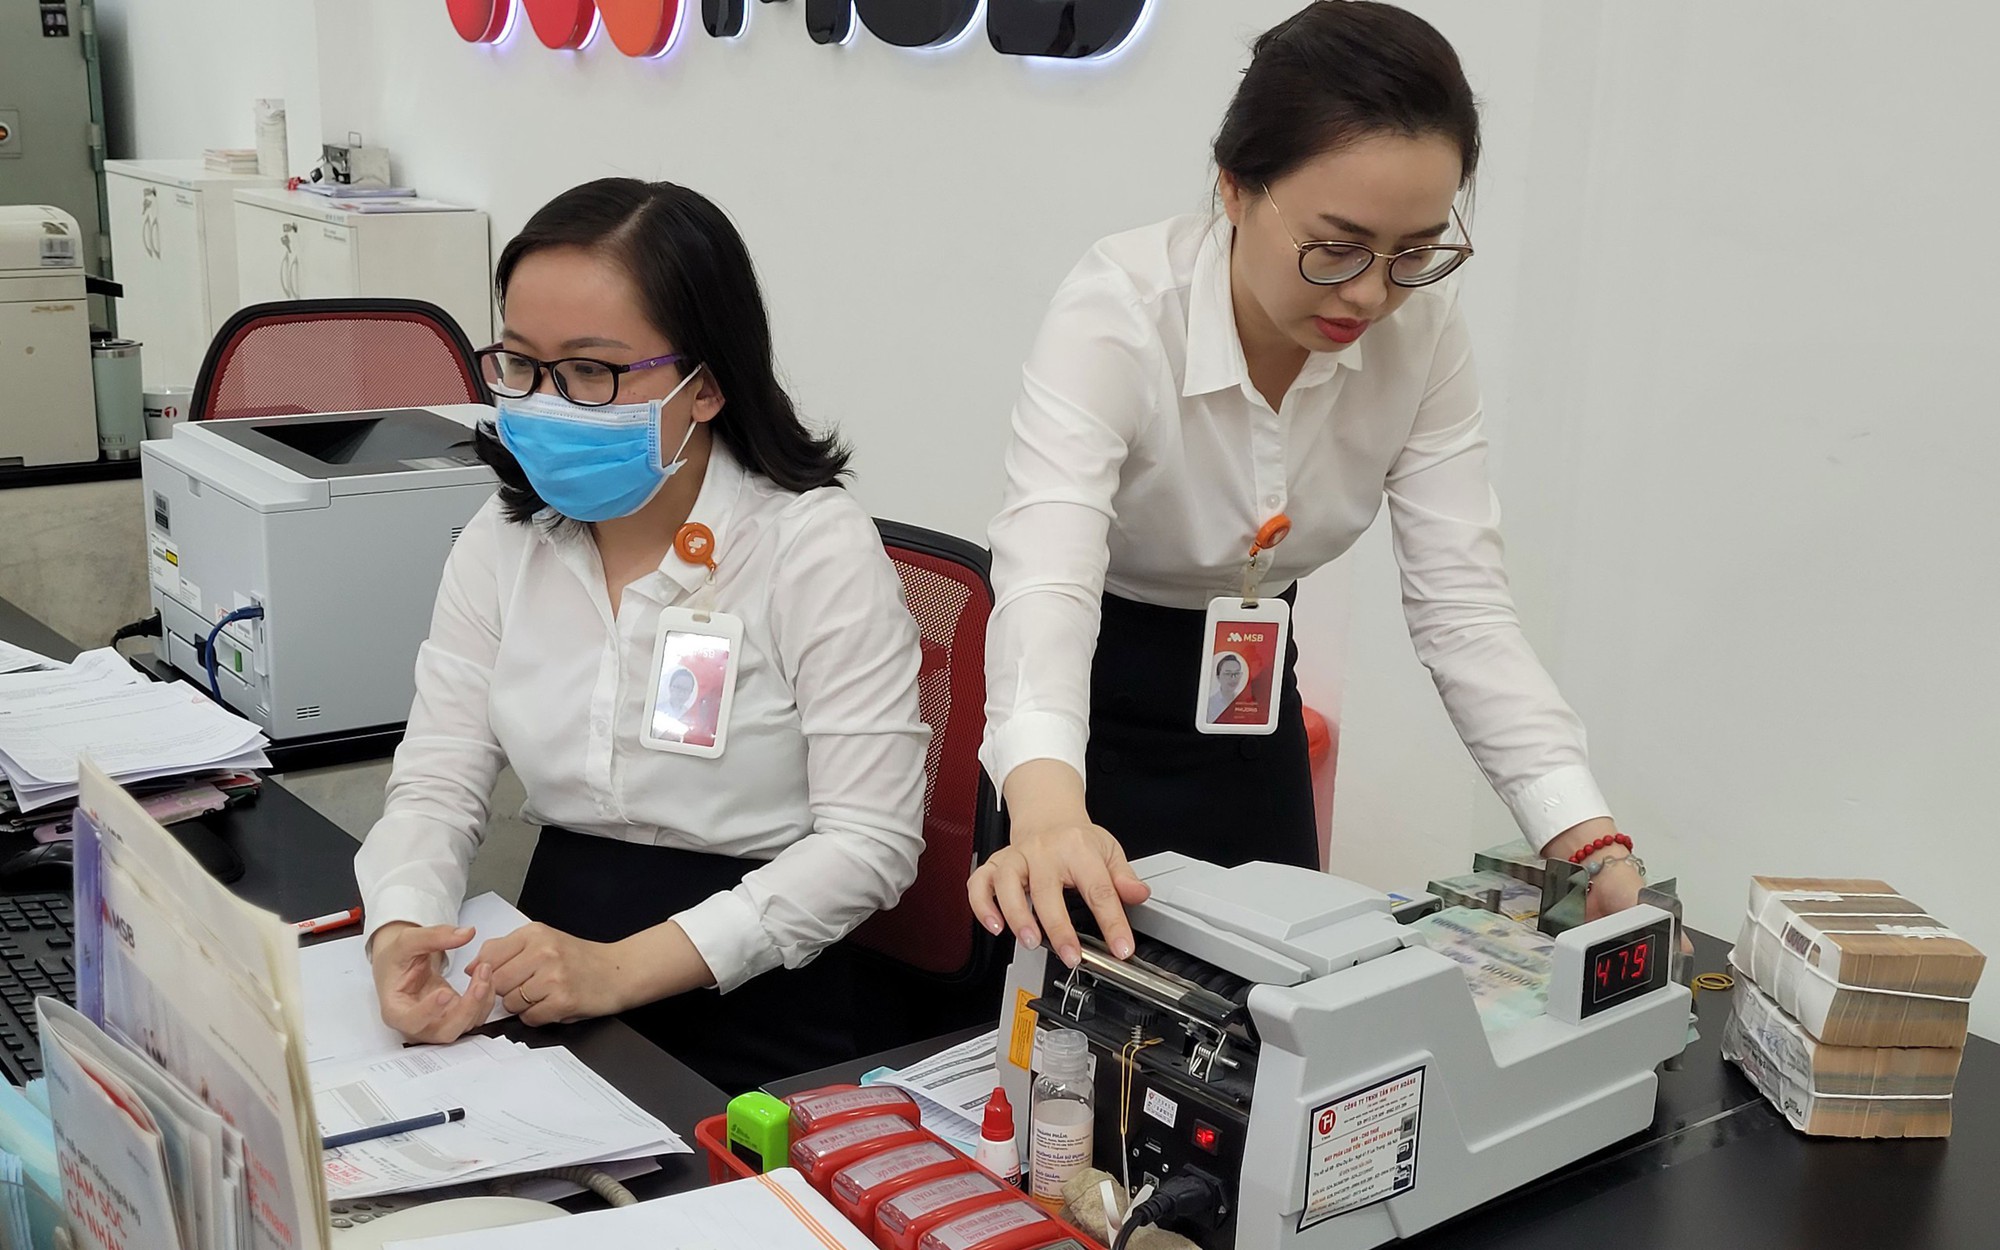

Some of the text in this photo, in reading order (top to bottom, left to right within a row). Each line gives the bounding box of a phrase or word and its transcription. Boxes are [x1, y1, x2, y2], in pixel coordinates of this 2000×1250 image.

[1244, 633, 1264, 642] MSB
[111, 910, 136, 949] MSB
[1597, 943, 1648, 986] 479
[60, 1151, 128, 1239] CHĂM SÓC
[67, 1188, 87, 1226] CÁ
